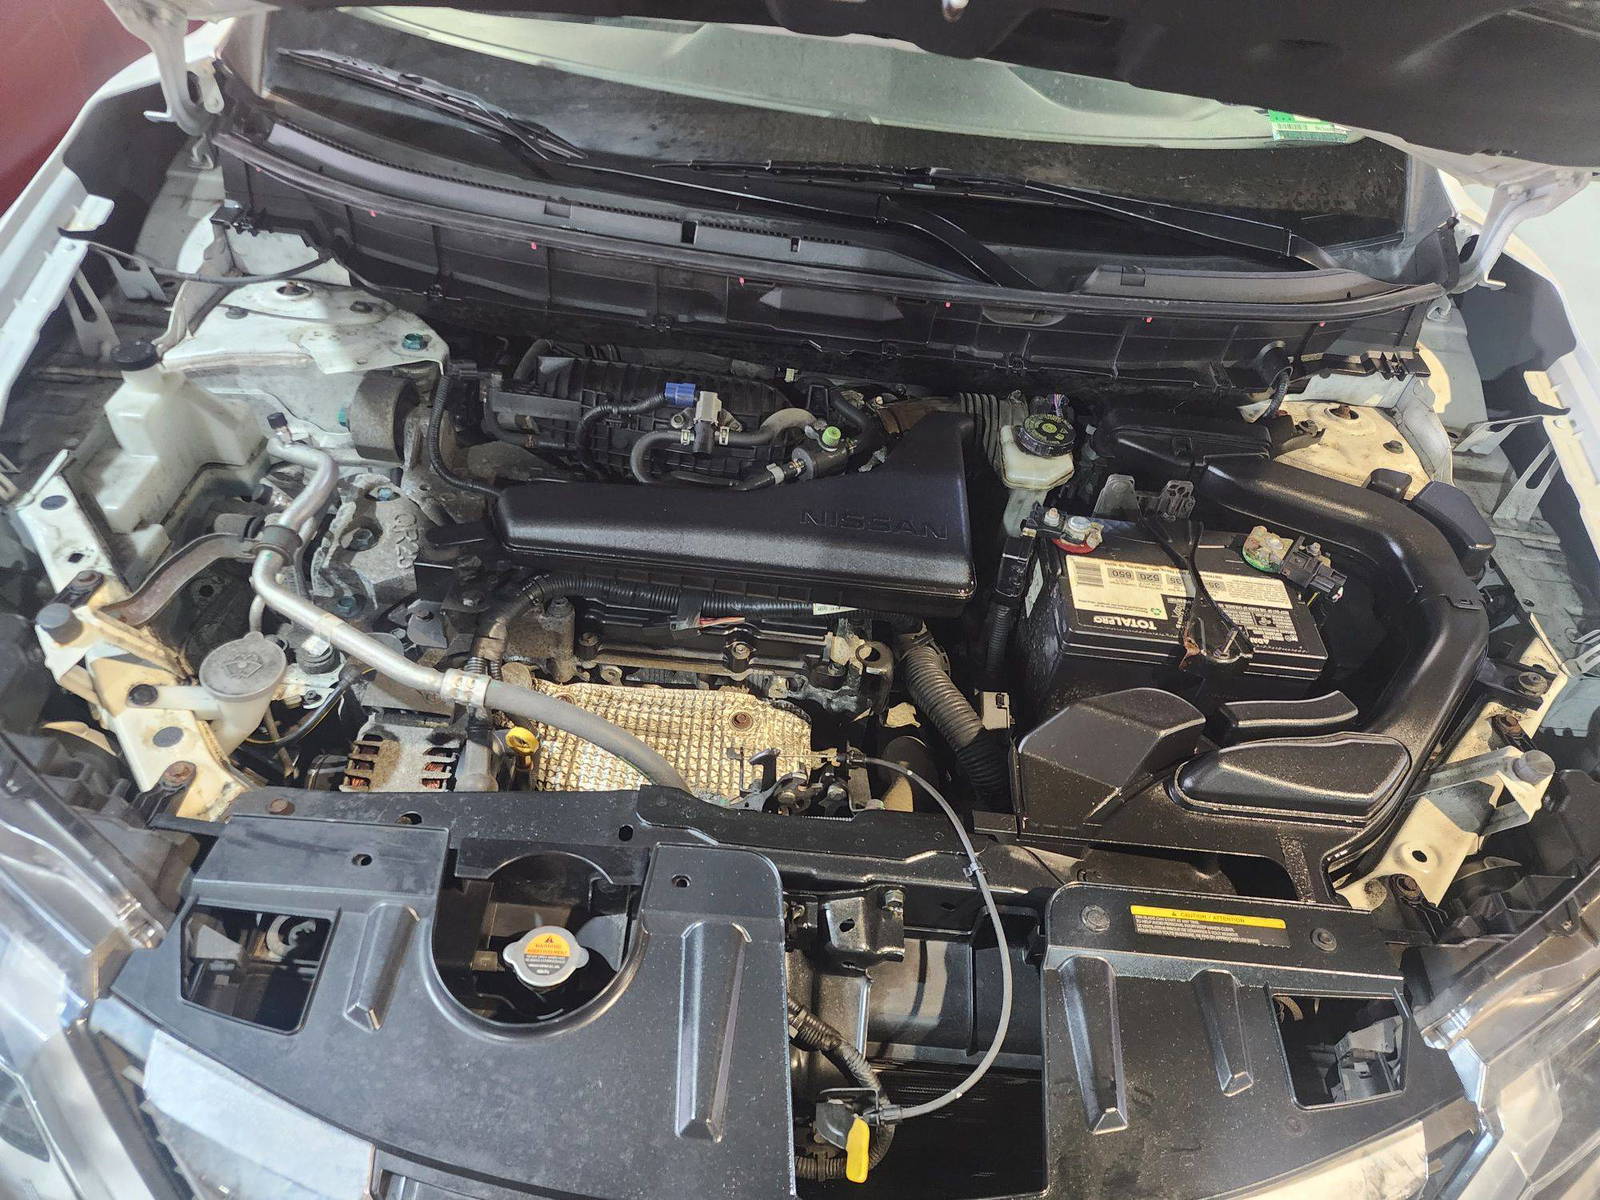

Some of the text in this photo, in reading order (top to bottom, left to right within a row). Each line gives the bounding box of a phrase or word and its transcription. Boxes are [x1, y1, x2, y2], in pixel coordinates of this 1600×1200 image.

[800, 511, 949, 540] NISSAN
[1111, 569, 1132, 578] 650
[1139, 572, 1160, 582] 520
[1093, 615, 1158, 630] TOTALPRO
